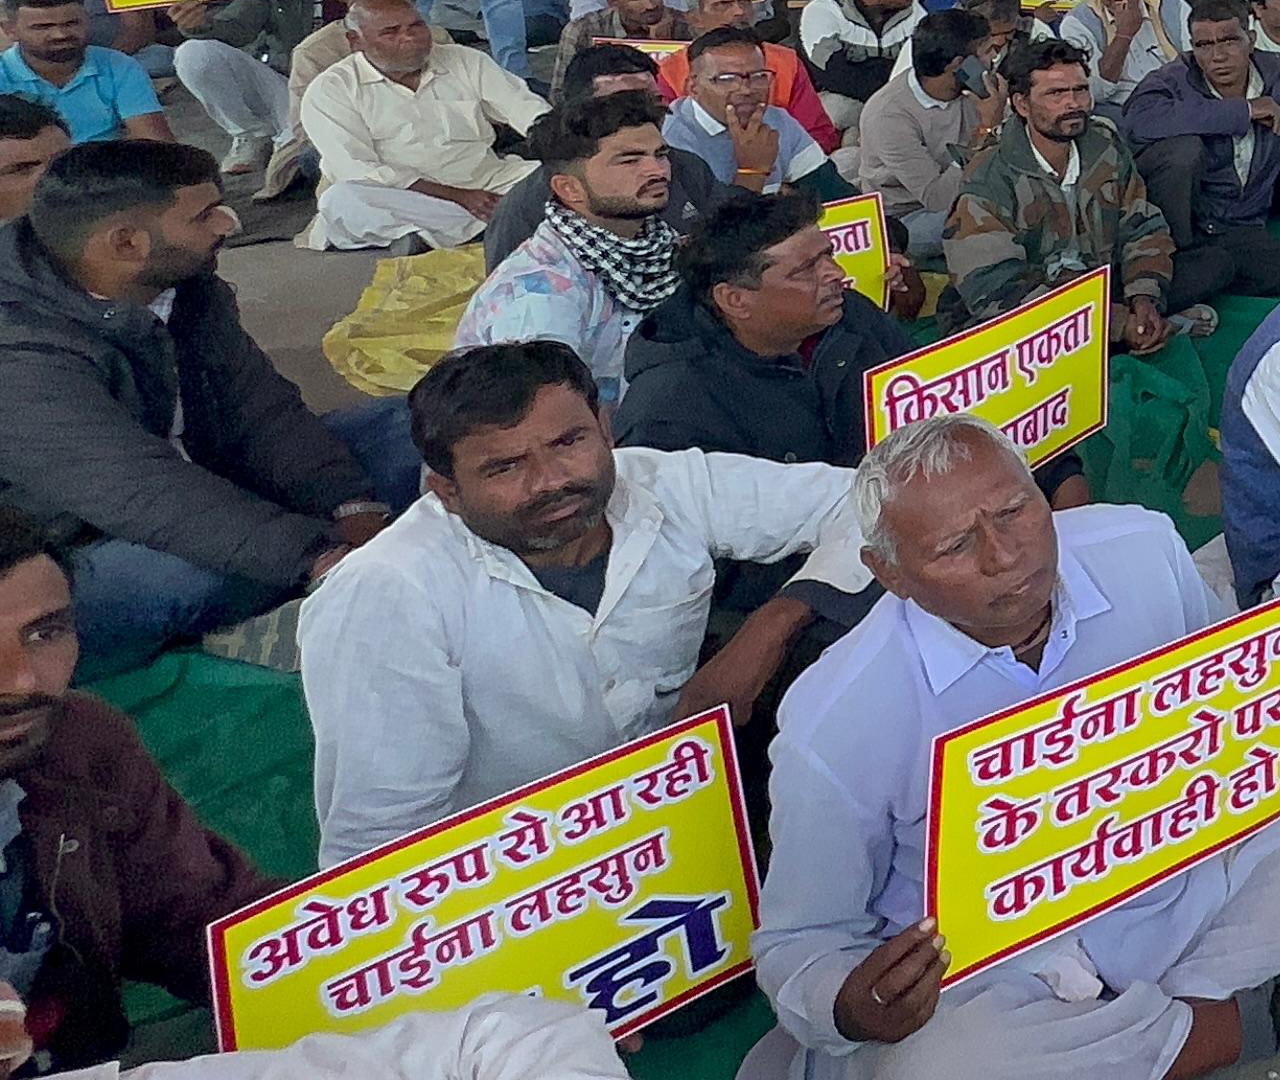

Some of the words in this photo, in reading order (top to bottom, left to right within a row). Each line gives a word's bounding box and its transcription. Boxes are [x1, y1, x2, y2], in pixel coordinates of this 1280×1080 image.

[885, 348, 1010, 433] किसान
[1015, 304, 1093, 383] एकता
[973, 694, 1141, 782] चाईना
[981, 797, 1041, 850] के
[1054, 711, 1225, 823] तस्करो
[247, 885, 390, 982] अवेध
[403, 844, 489, 906] रुप
[498, 813, 550, 864] से
[561, 786, 627, 840] आ
[632, 741, 711, 804] रही
[990, 773, 1220, 917] कार्यवाही
[1229, 748, 1279, 811] हो
[327, 922, 498, 1013] चाईना
[506, 830, 666, 932] लहसुन
[569, 895, 729, 1028] हो
